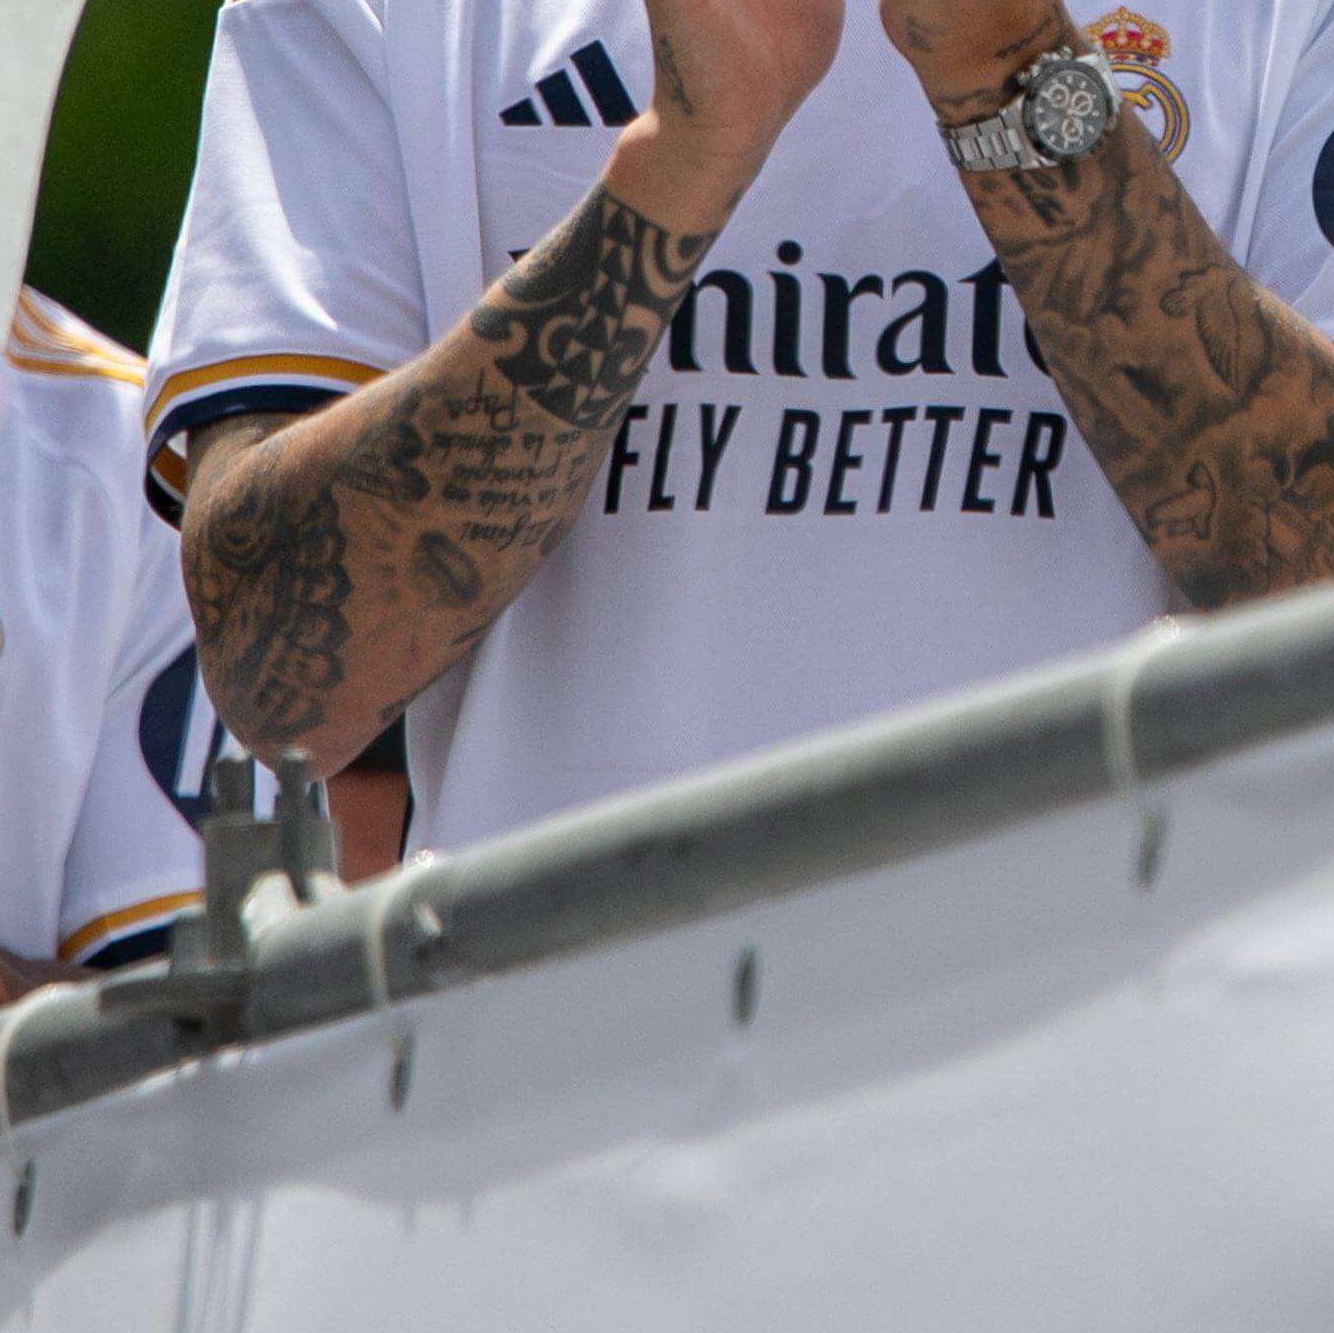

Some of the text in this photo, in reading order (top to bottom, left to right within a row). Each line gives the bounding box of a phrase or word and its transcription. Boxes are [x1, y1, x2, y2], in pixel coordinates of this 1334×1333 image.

[508, 239, 1053, 381] mirat
[604, 403, 1068, 519] FLY BETTER
